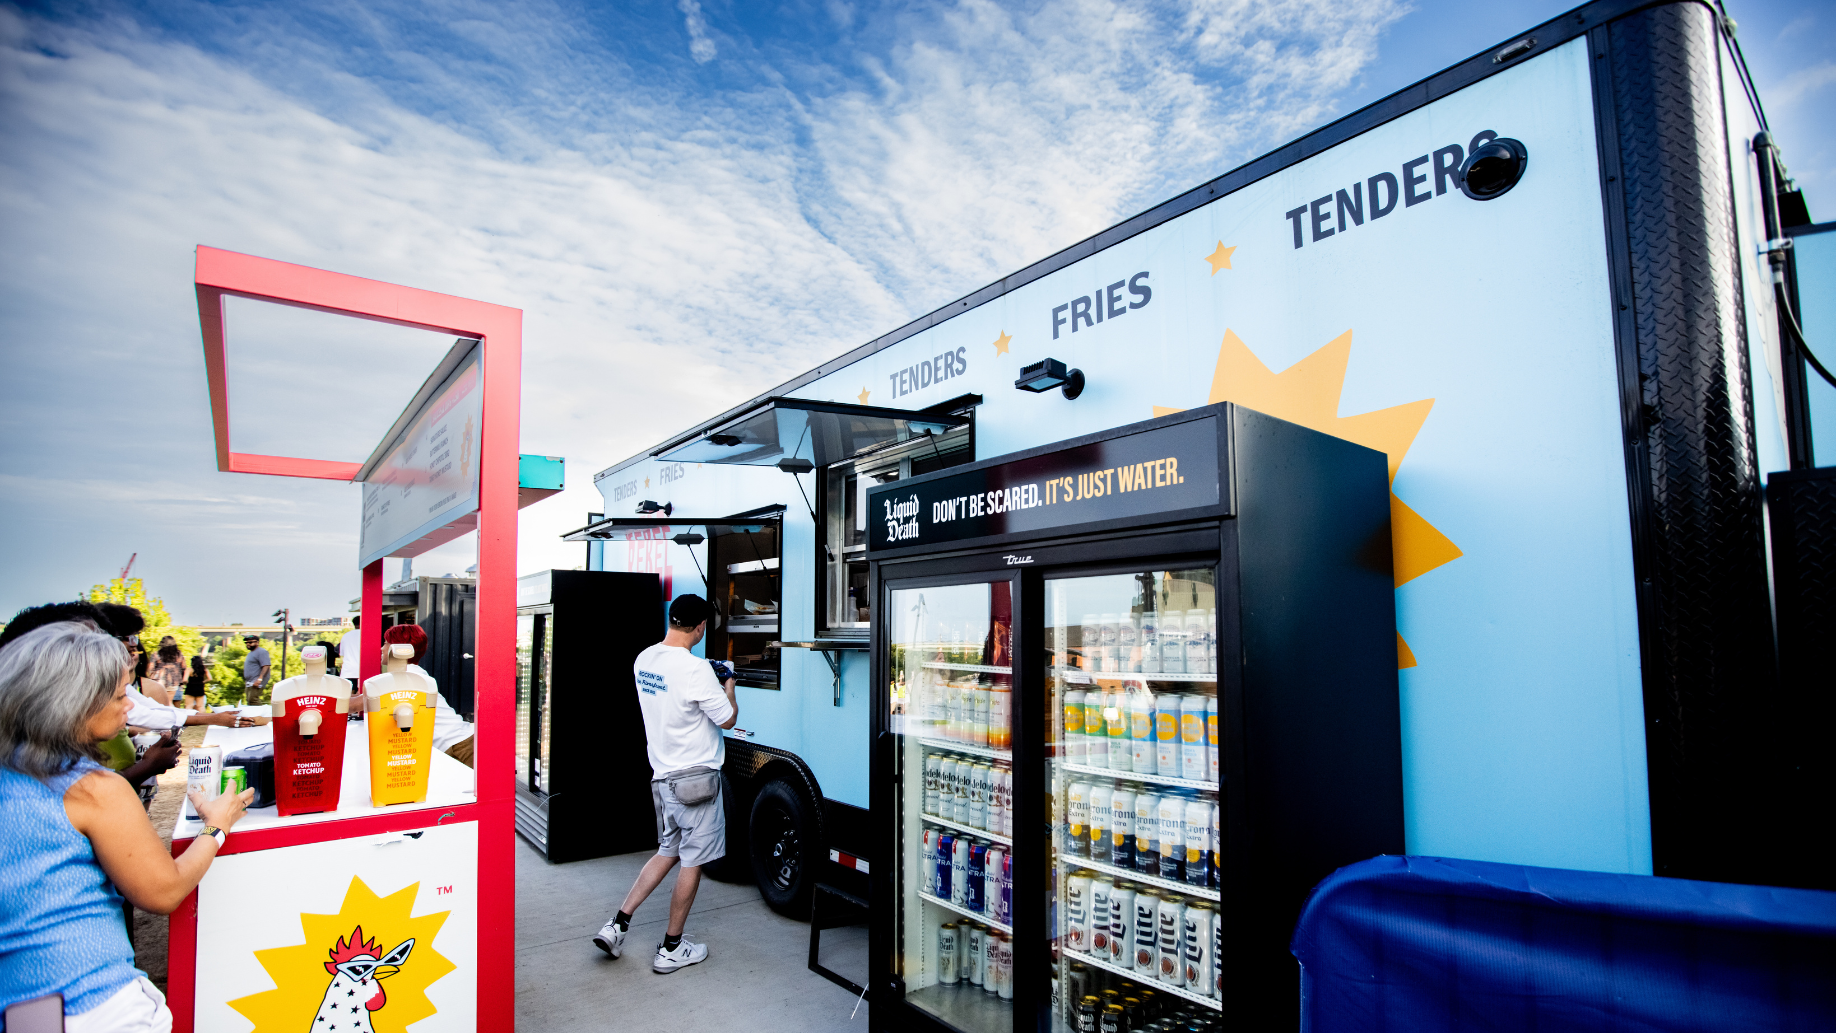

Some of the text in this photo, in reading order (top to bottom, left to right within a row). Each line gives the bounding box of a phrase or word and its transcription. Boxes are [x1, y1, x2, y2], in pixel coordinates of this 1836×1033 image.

[1052, 271, 1152, 340] FRIES
[890, 346, 967, 400] TENDERS
[660, 462, 685, 486] FRIES
[614, 479, 638, 503] TENDERS
[932, 456, 1184, 524] DON'T BE SCARED. IT'S JUST WATER.
[884, 494, 920, 524] Liquid
[886, 518, 920, 542] Death
[656, 674, 663, 682] ON
[296, 696, 326, 706] HEINZ
[390, 692, 418, 700] HEINZ
[388, 748, 416, 756] MUSTARD
[292, 779, 323, 787] KETCHUP
[387, 770, 416, 778] MUSTARD
[387, 781, 415, 789] MUSTARD
[436, 886, 453, 896] TM
[1136, 905, 1158, 948] Lite
[1159, 912, 1180, 957] Lite
